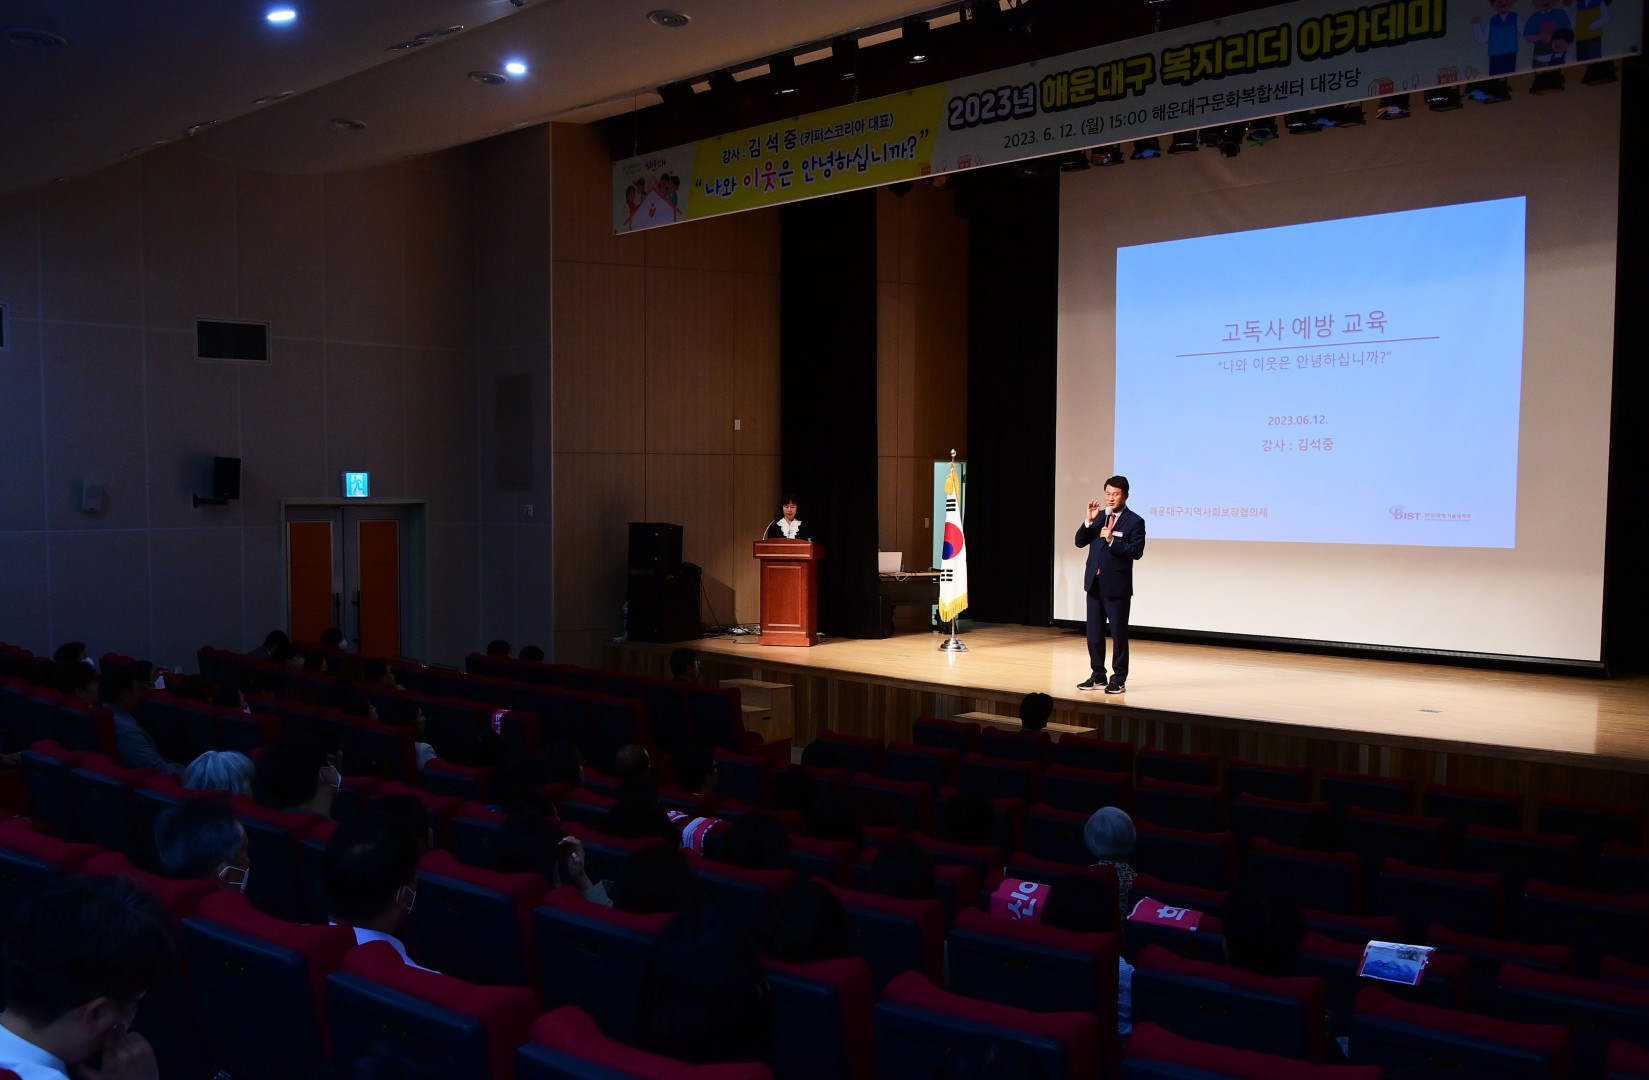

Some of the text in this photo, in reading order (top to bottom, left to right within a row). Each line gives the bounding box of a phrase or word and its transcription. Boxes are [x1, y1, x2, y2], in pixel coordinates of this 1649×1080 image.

[948, 0, 1446, 131] 2023년 해운대구 복지리더 아카데미
[1004, 68, 1361, 148] 2023. 6. 12. (월) 15:00 해운대구문화복합센터 대강당
[800, 119, 865, 146] (키퍼스코리아
[868, 113, 894, 130] 대표)
[743, 160, 794, 191] 이웃은
[1222, 310, 1388, 343] 고독사 예방 교육
[1253, 355, 1291, 371] 이웃은
[1268, 414, 1329, 426] 2023.06.12.
[1298, 437, 1334, 452] 김석중
[1150, 506, 1268, 518] 해운대구지역사회보장협의체
[1393, 508, 1420, 520] BIST
